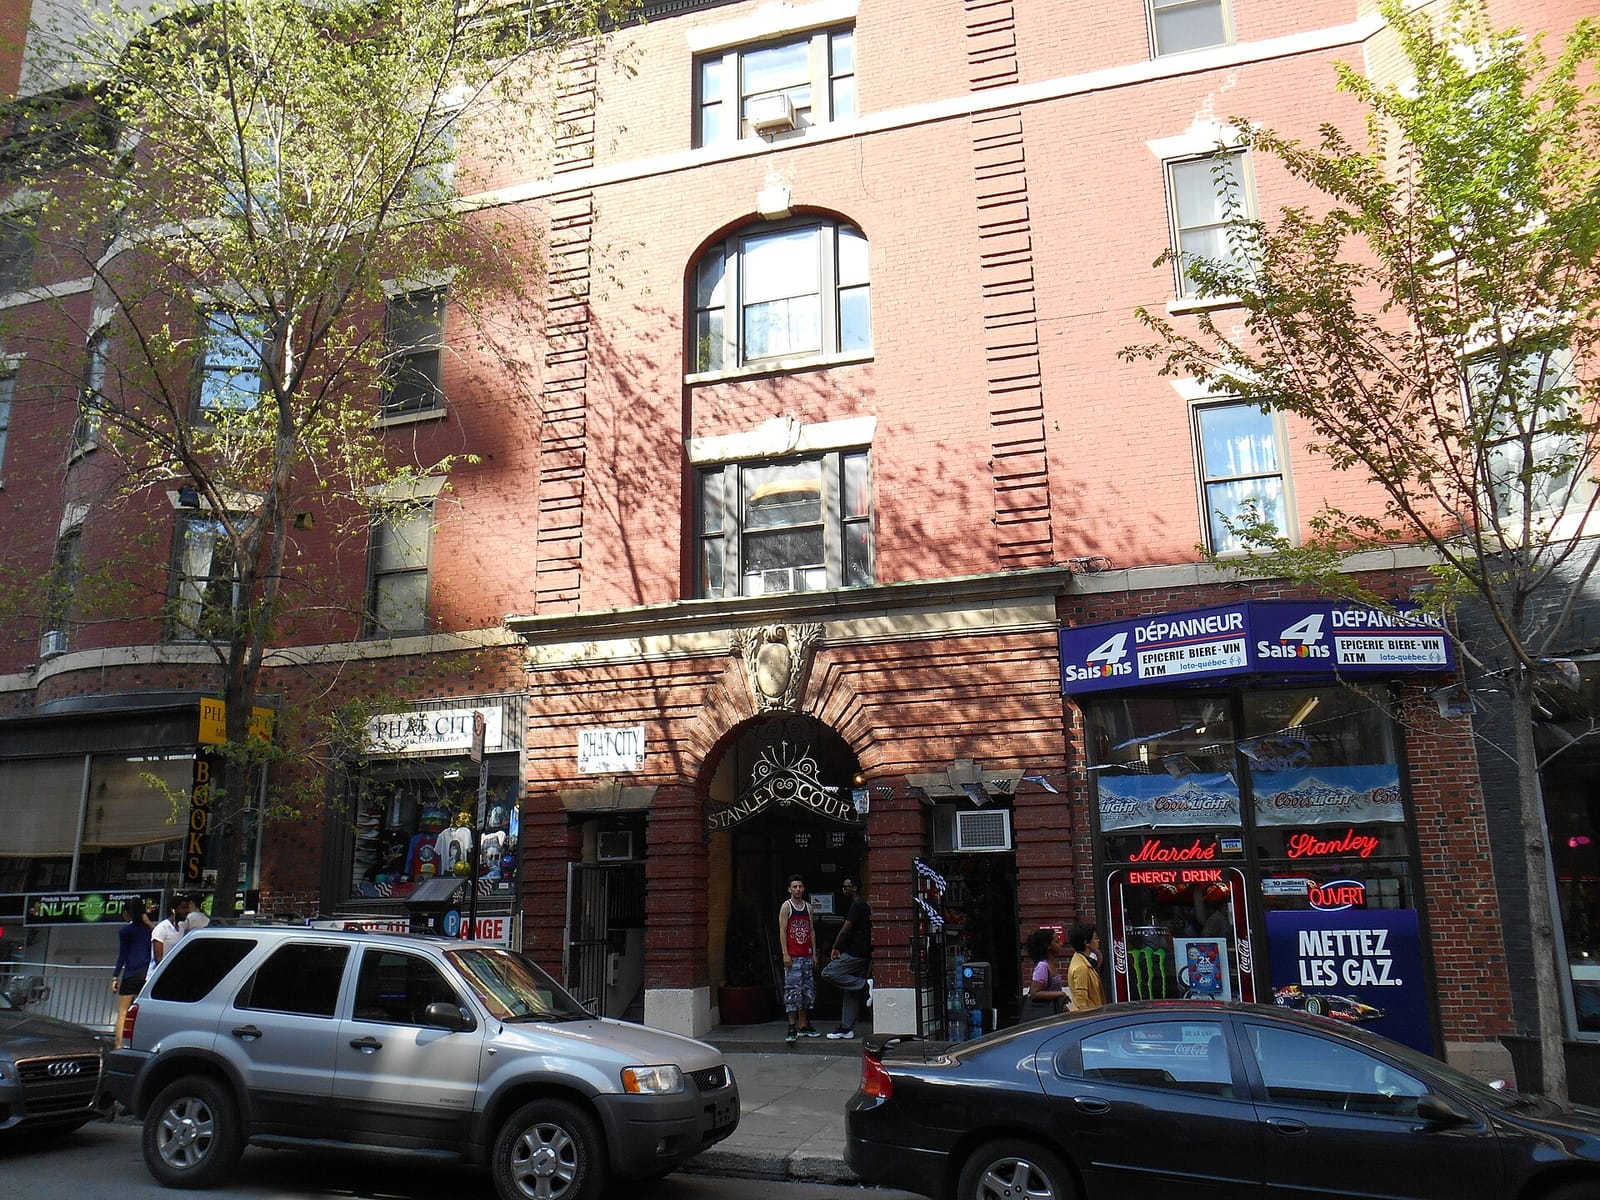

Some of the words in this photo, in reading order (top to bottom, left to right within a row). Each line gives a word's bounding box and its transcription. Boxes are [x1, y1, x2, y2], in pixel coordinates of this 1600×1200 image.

[1134, 612, 1244, 644] DÉPANNEUR
[1280, 613, 1325, 645] 4
[1086, 632, 1129, 665] 4
[1257, 640, 1331, 658] Saisons
[1340, 639, 1384, 650] EPICERIE
[1142, 649, 1185, 665] EPICERIE
[1343, 652, 1366, 663] ATM
[1065, 660, 1133, 682] Saisons
[1143, 664, 1166, 677] ATM
[435, 714, 475, 736] CIT
[583, 731, 612, 757] PHAT
[614, 729, 640, 757] CITY
[707, 782, 776, 830] STANLEY
[1154, 796, 1191, 812] Coors
[1190, 798, 1230, 811] LIGHT
[1274, 791, 1313, 809] Coors
[1311, 793, 1354, 807] LIGHT
[188, 760, 210, 880] BOOKS
[1129, 838, 1218, 862] Marché
[1287, 827, 1380, 859] Stanley
[1129, 871, 1178, 884] ENERGY
[1182, 869, 1223, 883] DRINK
[1309, 887, 1365, 906] OUVERT
[1298, 929, 1391, 957] METTEZ
[1298, 958, 1339, 986] LES
[1341, 958, 1403, 986] GAZ.
